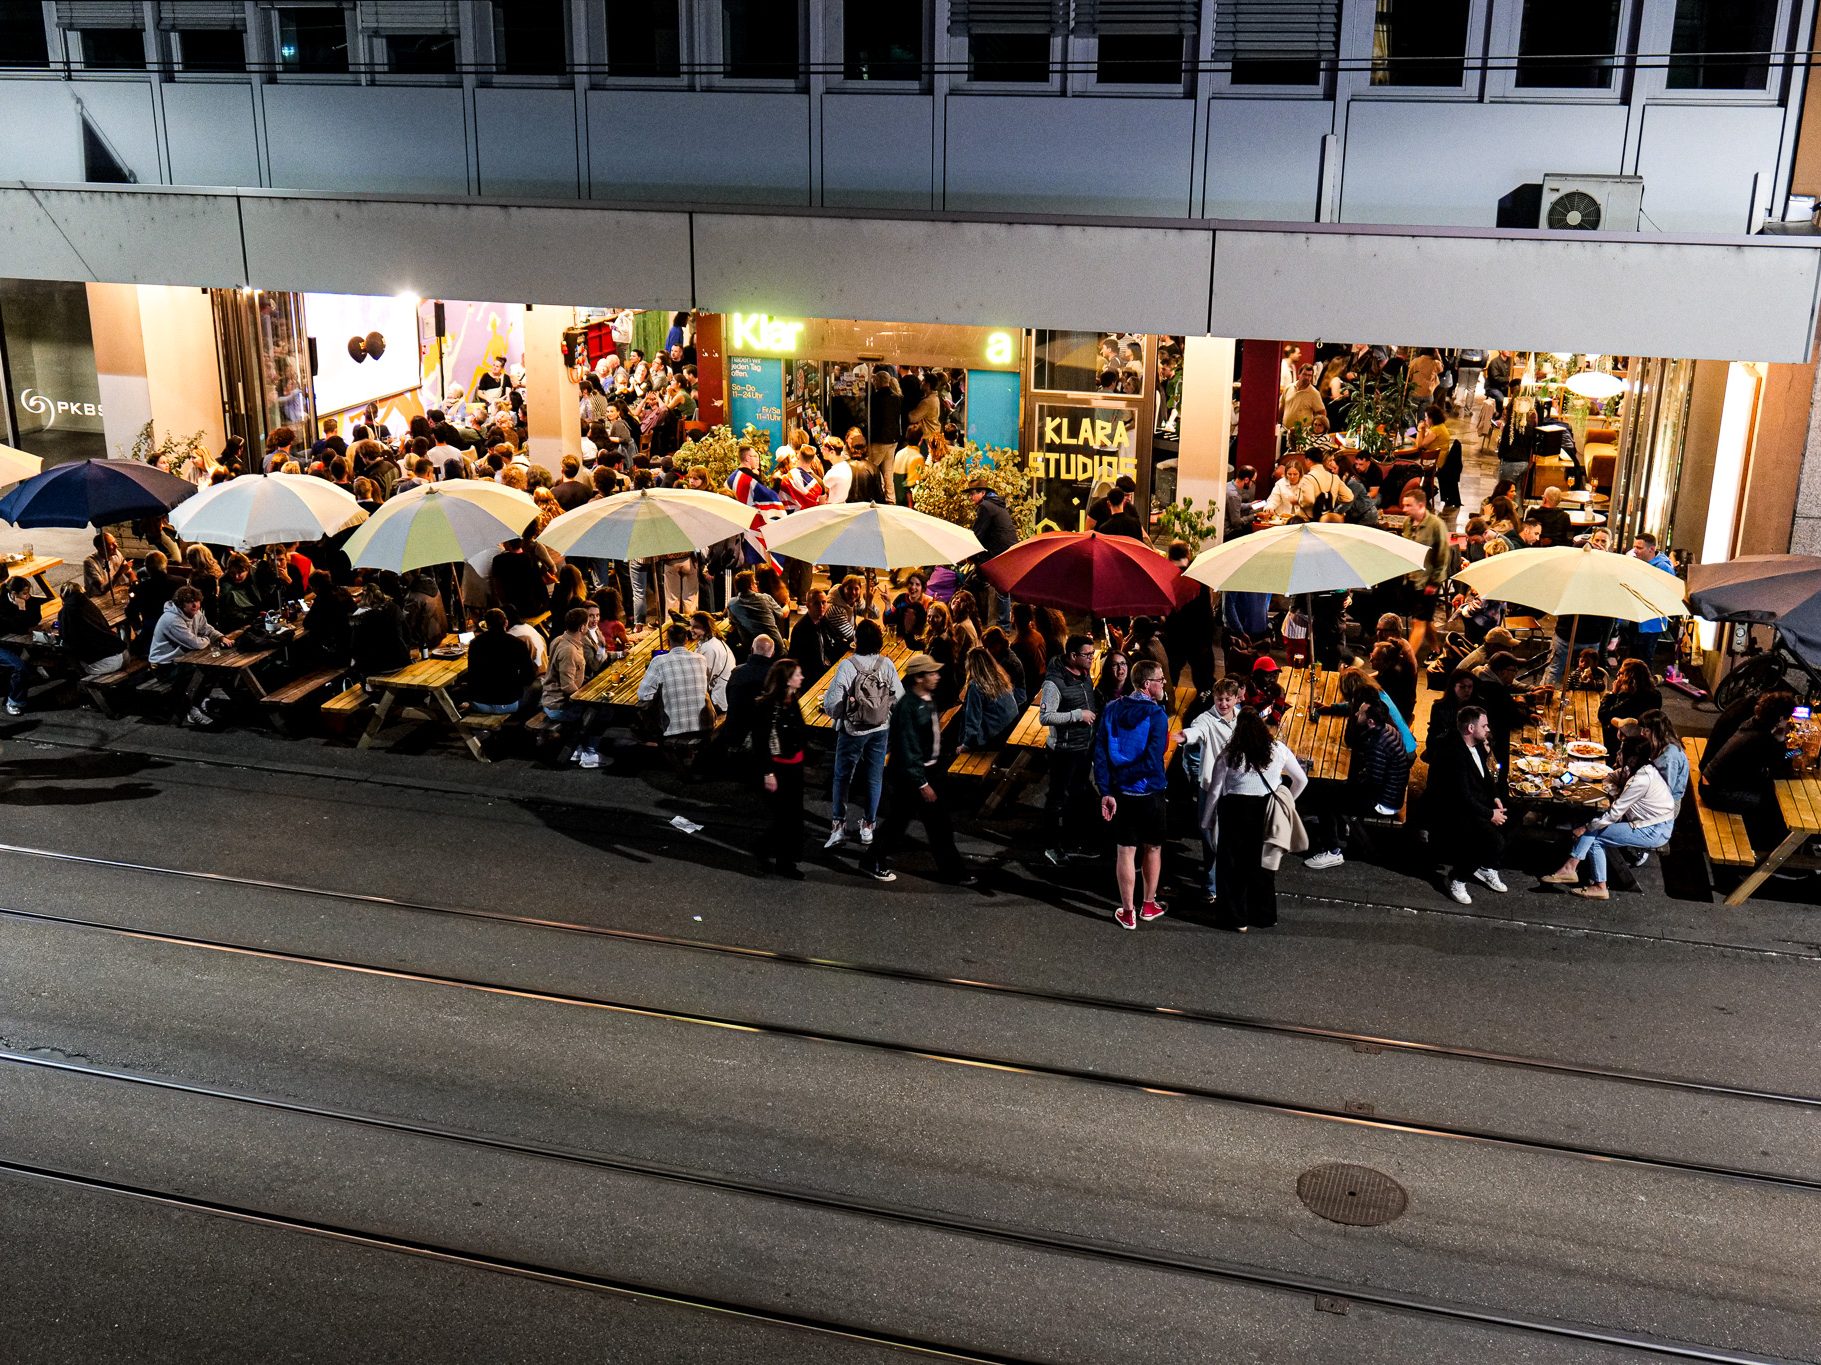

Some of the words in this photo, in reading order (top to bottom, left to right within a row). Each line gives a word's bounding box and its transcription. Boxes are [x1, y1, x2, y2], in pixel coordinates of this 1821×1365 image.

[733, 312, 804, 351] Klar
[986, 332, 1012, 363] a
[750, 363, 761, 372] Tag
[752, 391, 763, 399] Uhr
[762, 406, 780, 414] Fr/Sa
[1045, 416, 1130, 448] KLARA
[1028, 451, 1138, 483] STUDIOS
